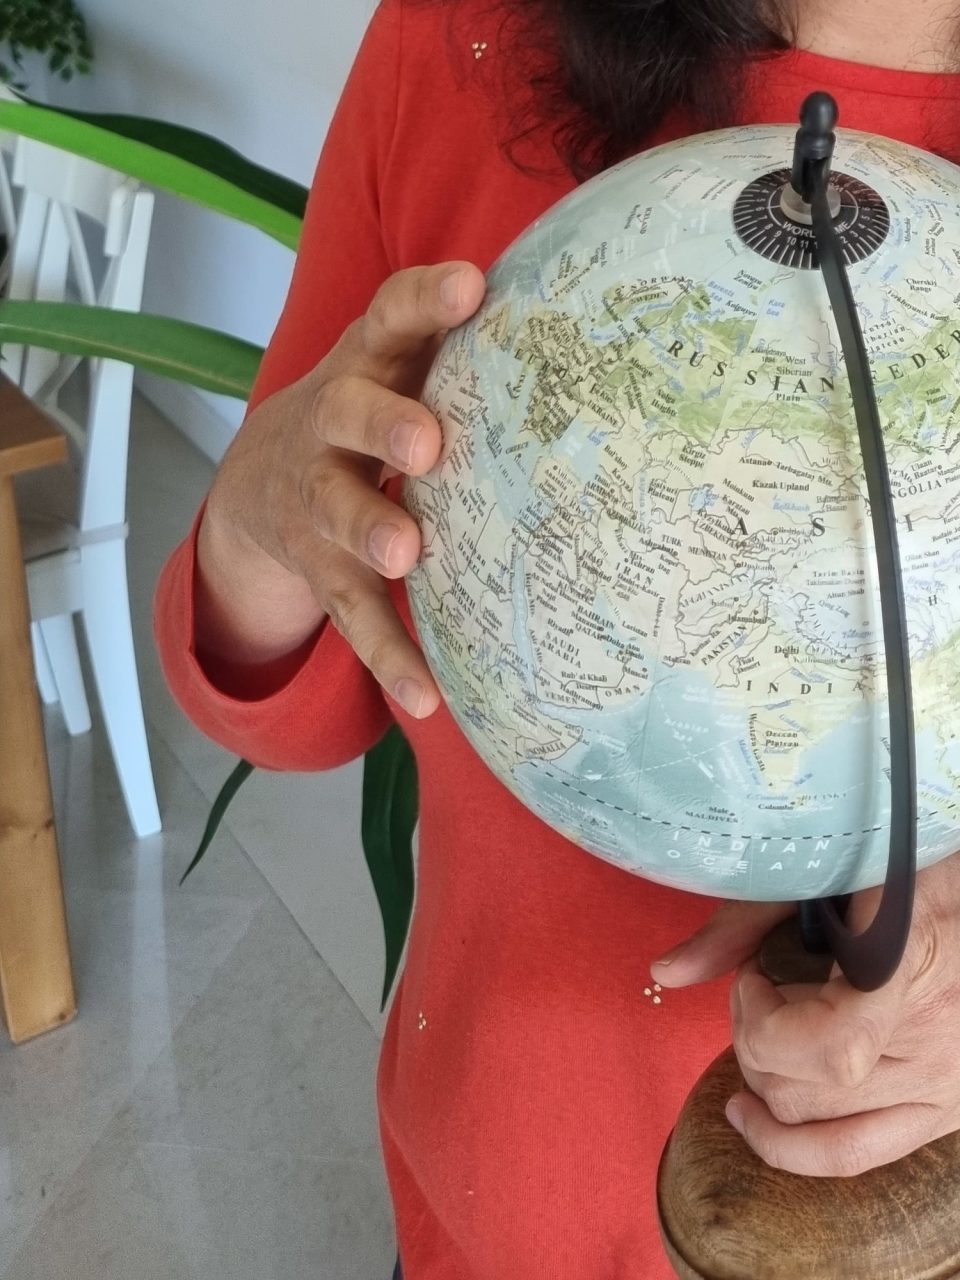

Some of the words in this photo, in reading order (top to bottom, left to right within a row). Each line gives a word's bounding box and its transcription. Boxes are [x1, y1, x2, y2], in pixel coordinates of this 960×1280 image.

[786, 355, 807, 366] West
[540, 639, 582, 669] ARABIA
[545, 631, 581, 657] SAUDI
[701, 624, 747, 666] PAKISTAN
[774, 644, 800, 657] Delhi
[746, 679, 865, 696] INDIA
